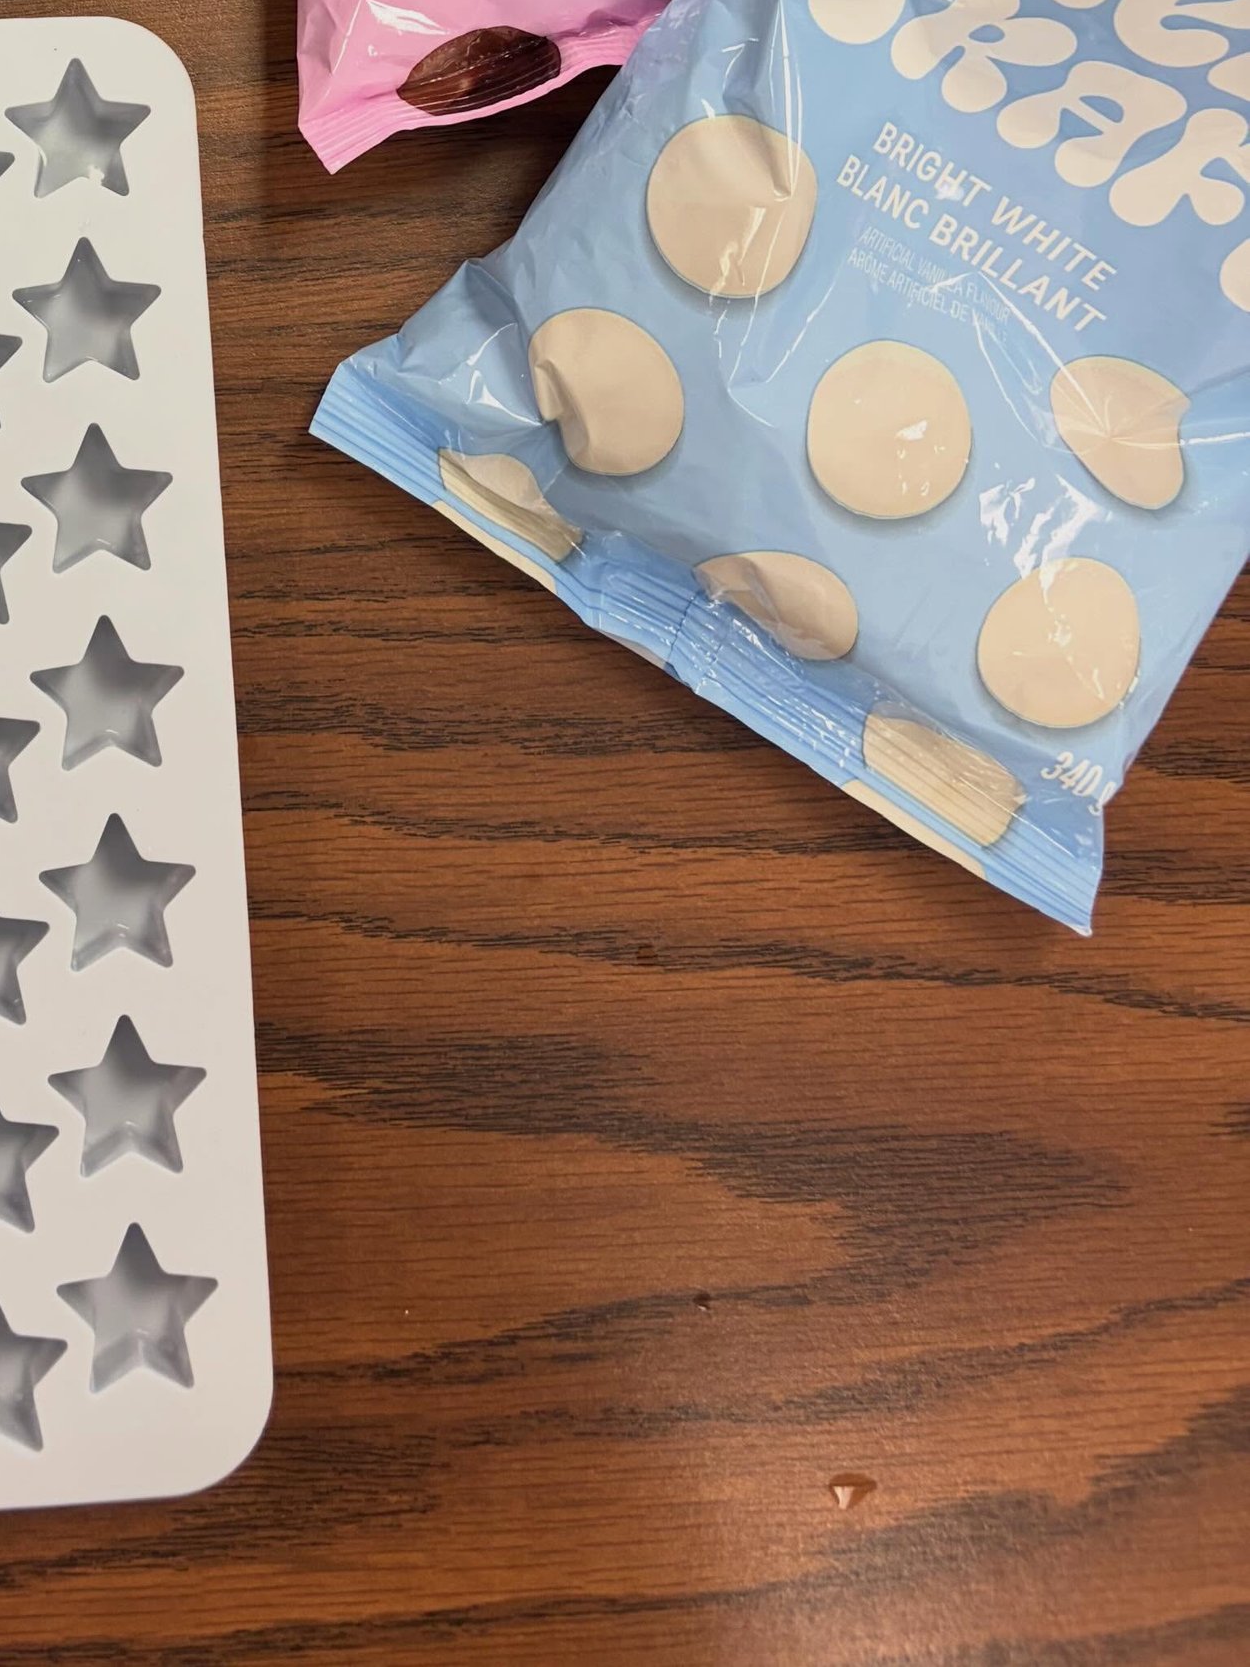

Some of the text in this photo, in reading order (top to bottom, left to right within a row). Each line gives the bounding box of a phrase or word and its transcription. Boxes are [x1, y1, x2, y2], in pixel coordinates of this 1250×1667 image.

[836, 154, 1107, 334] BLANC BRILLANT
[872, 121, 1118, 291] BRIGHT WHITE
